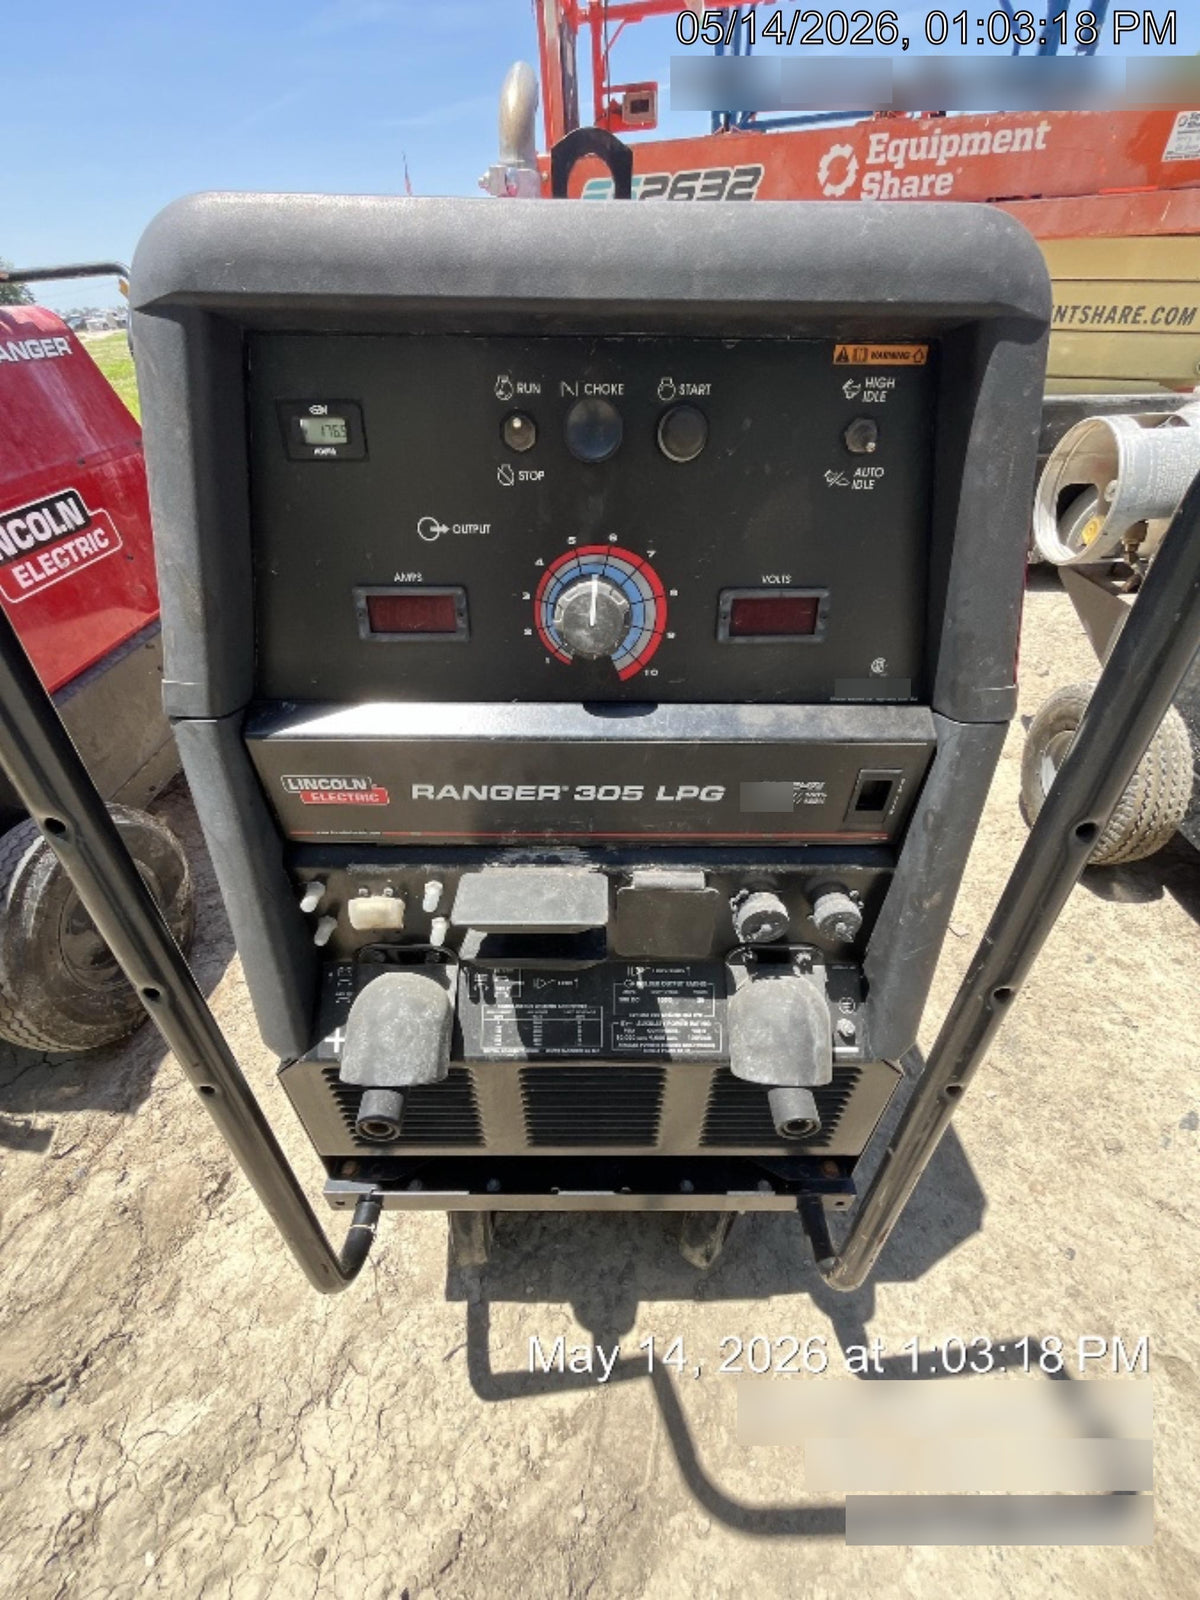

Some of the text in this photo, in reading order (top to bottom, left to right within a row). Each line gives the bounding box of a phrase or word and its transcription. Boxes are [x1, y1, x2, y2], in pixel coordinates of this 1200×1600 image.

[865, 125, 1050, 169] Equipment
[861, 171, 953, 200] Share
[1051, 304, 1197, 325] NTSHARE.COM
[516, 383, 541, 394] RUN
[864, 376, 895, 389] HIGH
[584, 383, 624, 396] CHOKE
[678, 383, 712, 396] START
[862, 390, 887, 403] IDLE
[518, 470, 545, 482] STOP
[853, 467, 885, 478] AUTO
[851, 479, 875, 490] IDLE
[452, 523, 491, 534] OUTPUT
[567, 536, 577, 545] 5
[11, 527, 110, 589] ELECTRIC
[646, 550, 657, 558] 7
[534, 557, 545, 567] 4
[394, 572, 422, 582] AMPS
[762, 574, 792, 584] VOLTS
[644, 668, 659, 677] 10
[287, 777, 367, 790] LINCOLN
[309, 790, 380, 803] ELECTRIC
[411, 783, 726, 802] RANGER 305 LPG
